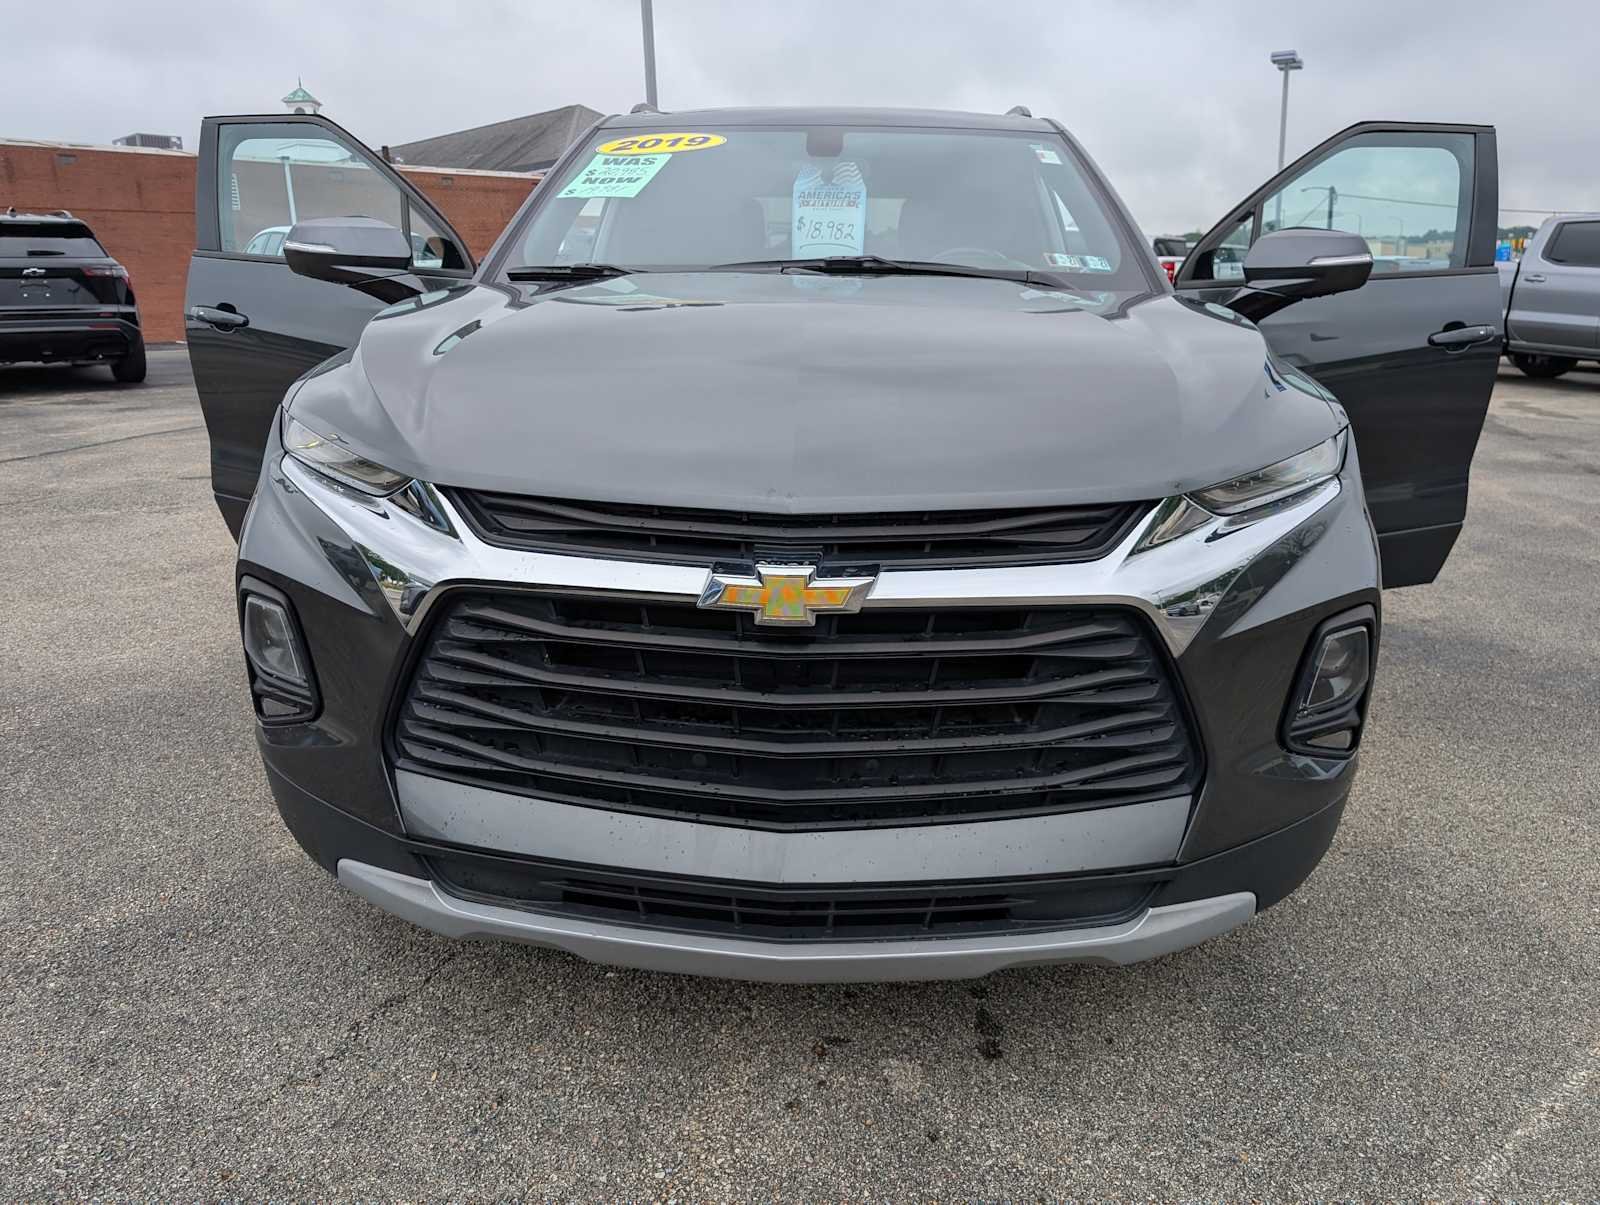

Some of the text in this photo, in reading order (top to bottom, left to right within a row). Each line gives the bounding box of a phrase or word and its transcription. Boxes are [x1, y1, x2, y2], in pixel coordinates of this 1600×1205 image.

[609, 136, 712, 152] 2019
[601, 157, 657, 166] WAS
[581, 176, 642, 184] NOW
